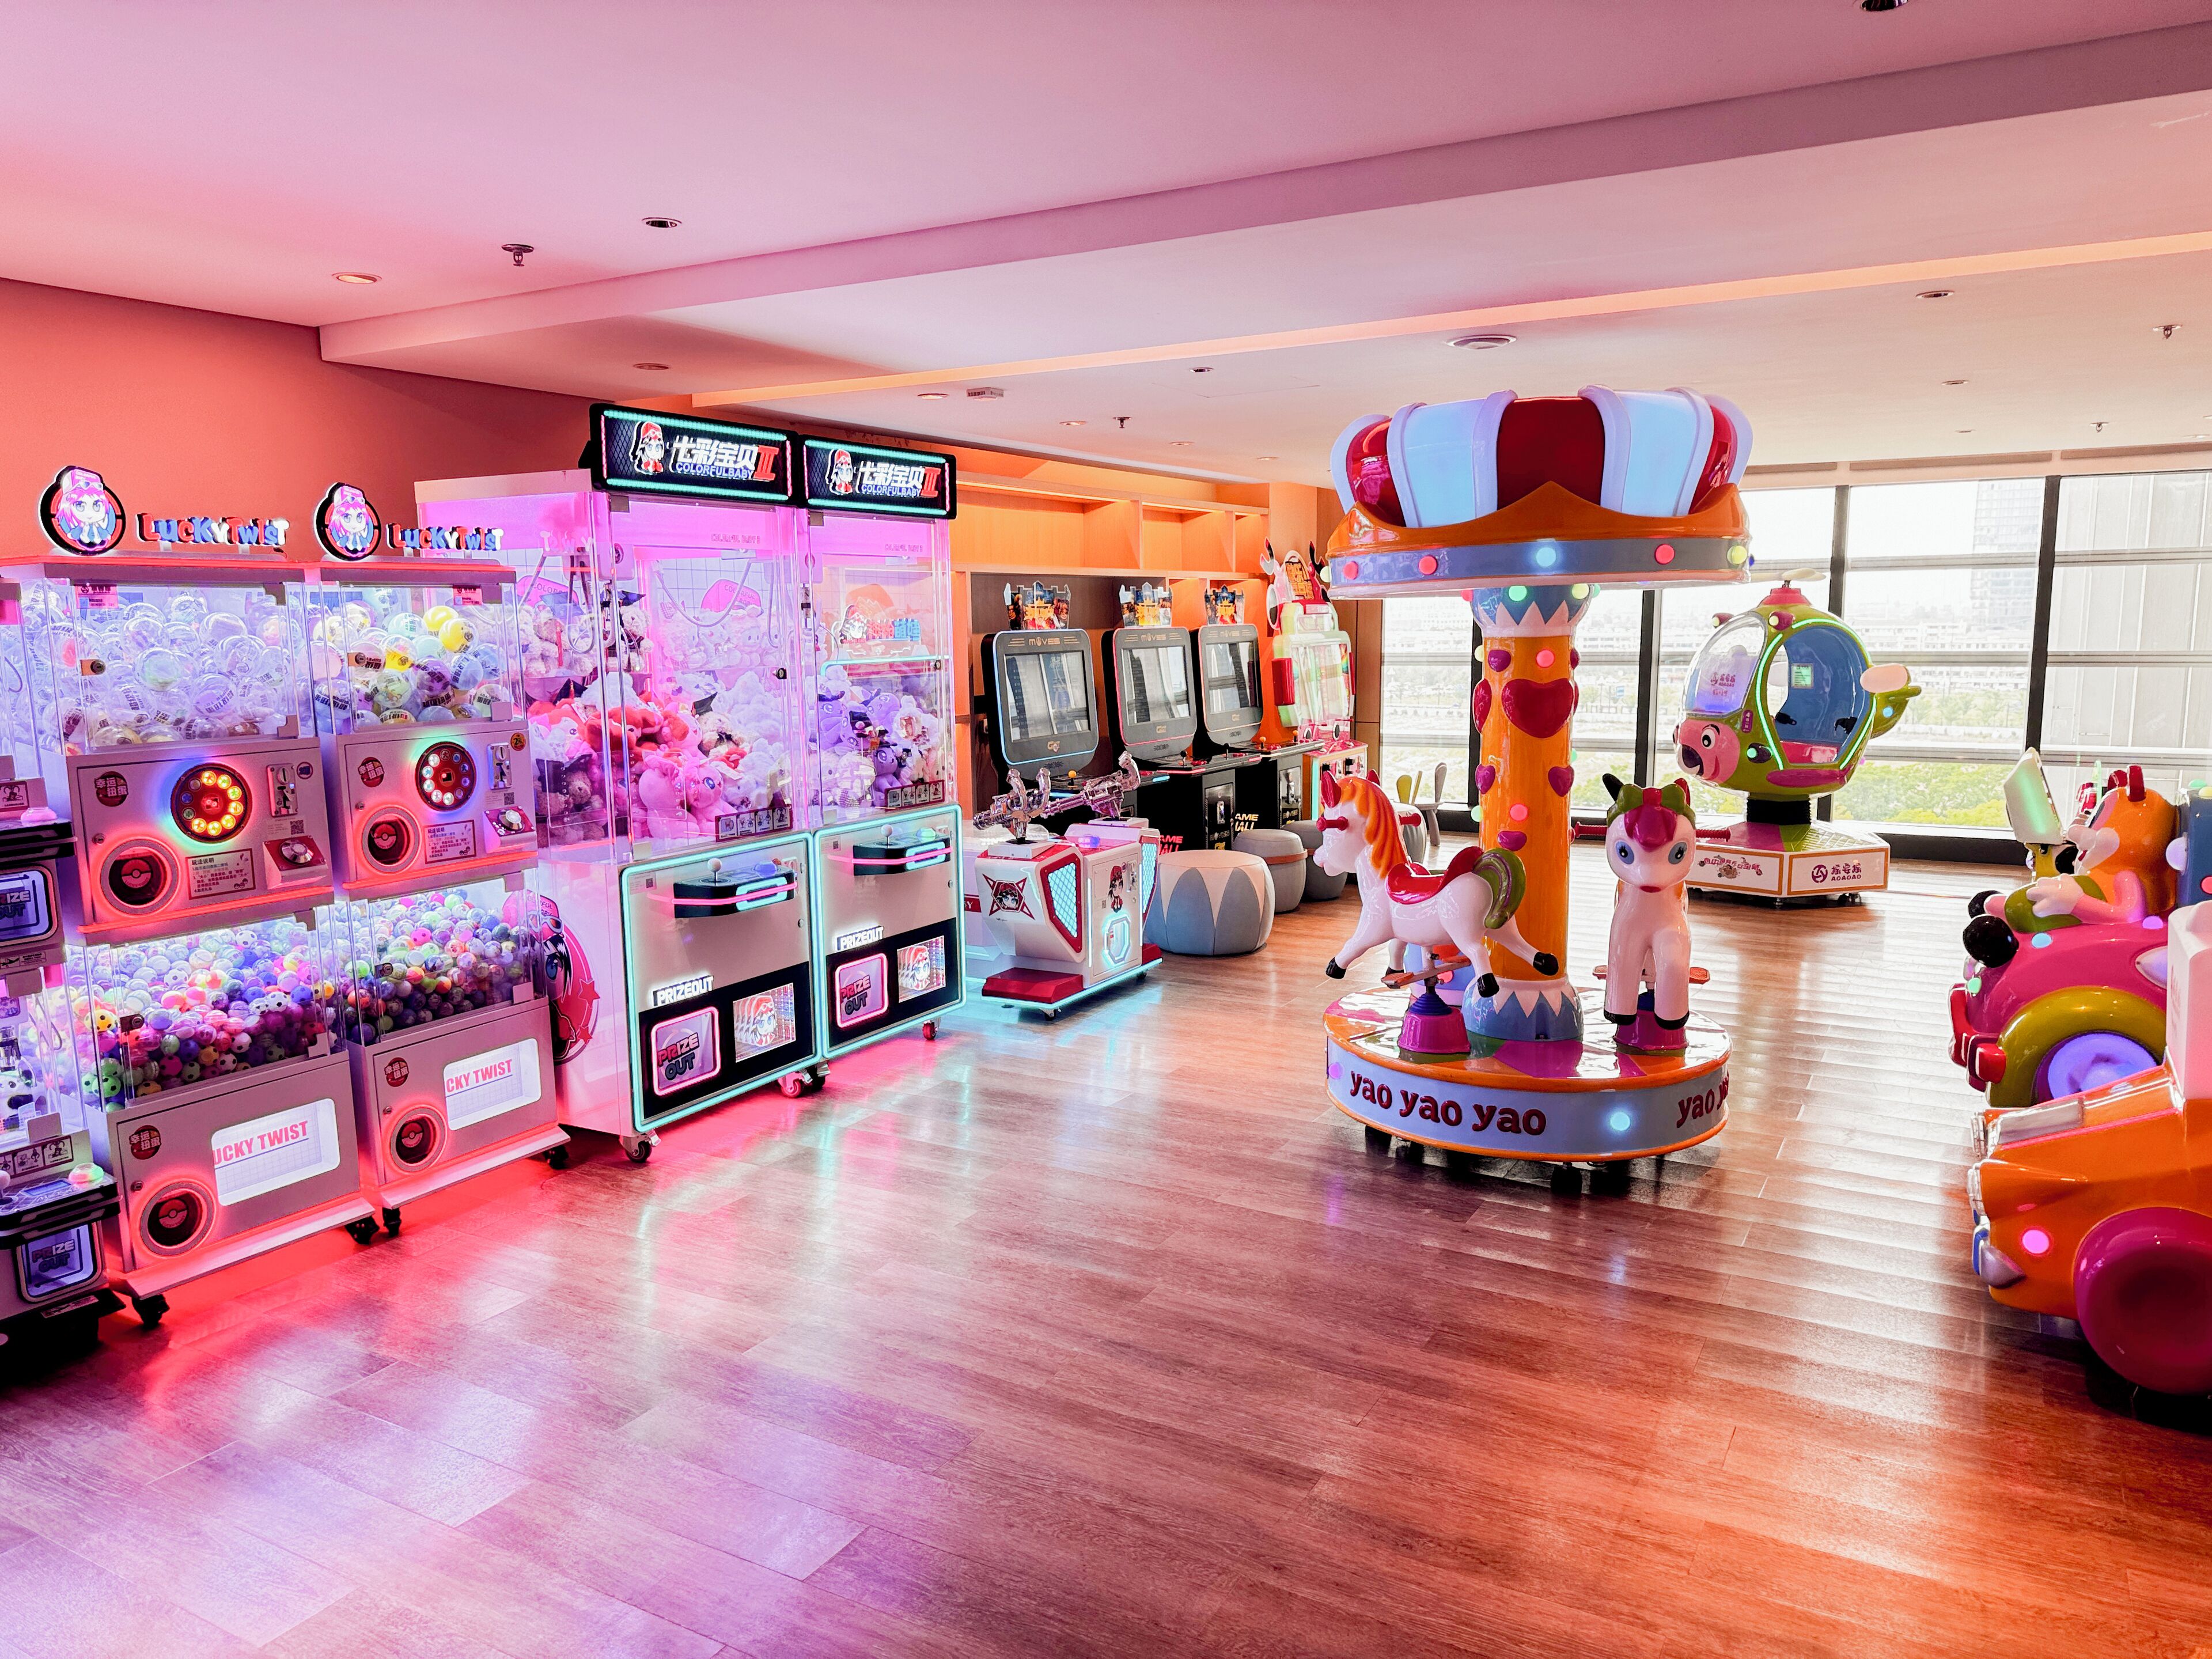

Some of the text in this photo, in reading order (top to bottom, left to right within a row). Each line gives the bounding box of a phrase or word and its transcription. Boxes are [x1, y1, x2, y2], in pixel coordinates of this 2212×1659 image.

[676, 461, 754, 479] COLORFULBABY
[861, 484, 921, 497] COLORFULBABY
[95, 778, 117, 789] 幸运
[840, 975, 871, 1002] PRIZE
[844, 992, 868, 1015] OUT
[658, 1032, 699, 1067] PRIZE
[446, 1059, 512, 1093] CKY TWIST
[665, 1052, 696, 1081] OUT
[1350, 1070, 1547, 1135] yao yao yao
[1676, 1089, 1715, 1128] yao
[213, 1120, 308, 1165] UCKY TWIST
[32, 1240, 75, 1263] PRIZE
